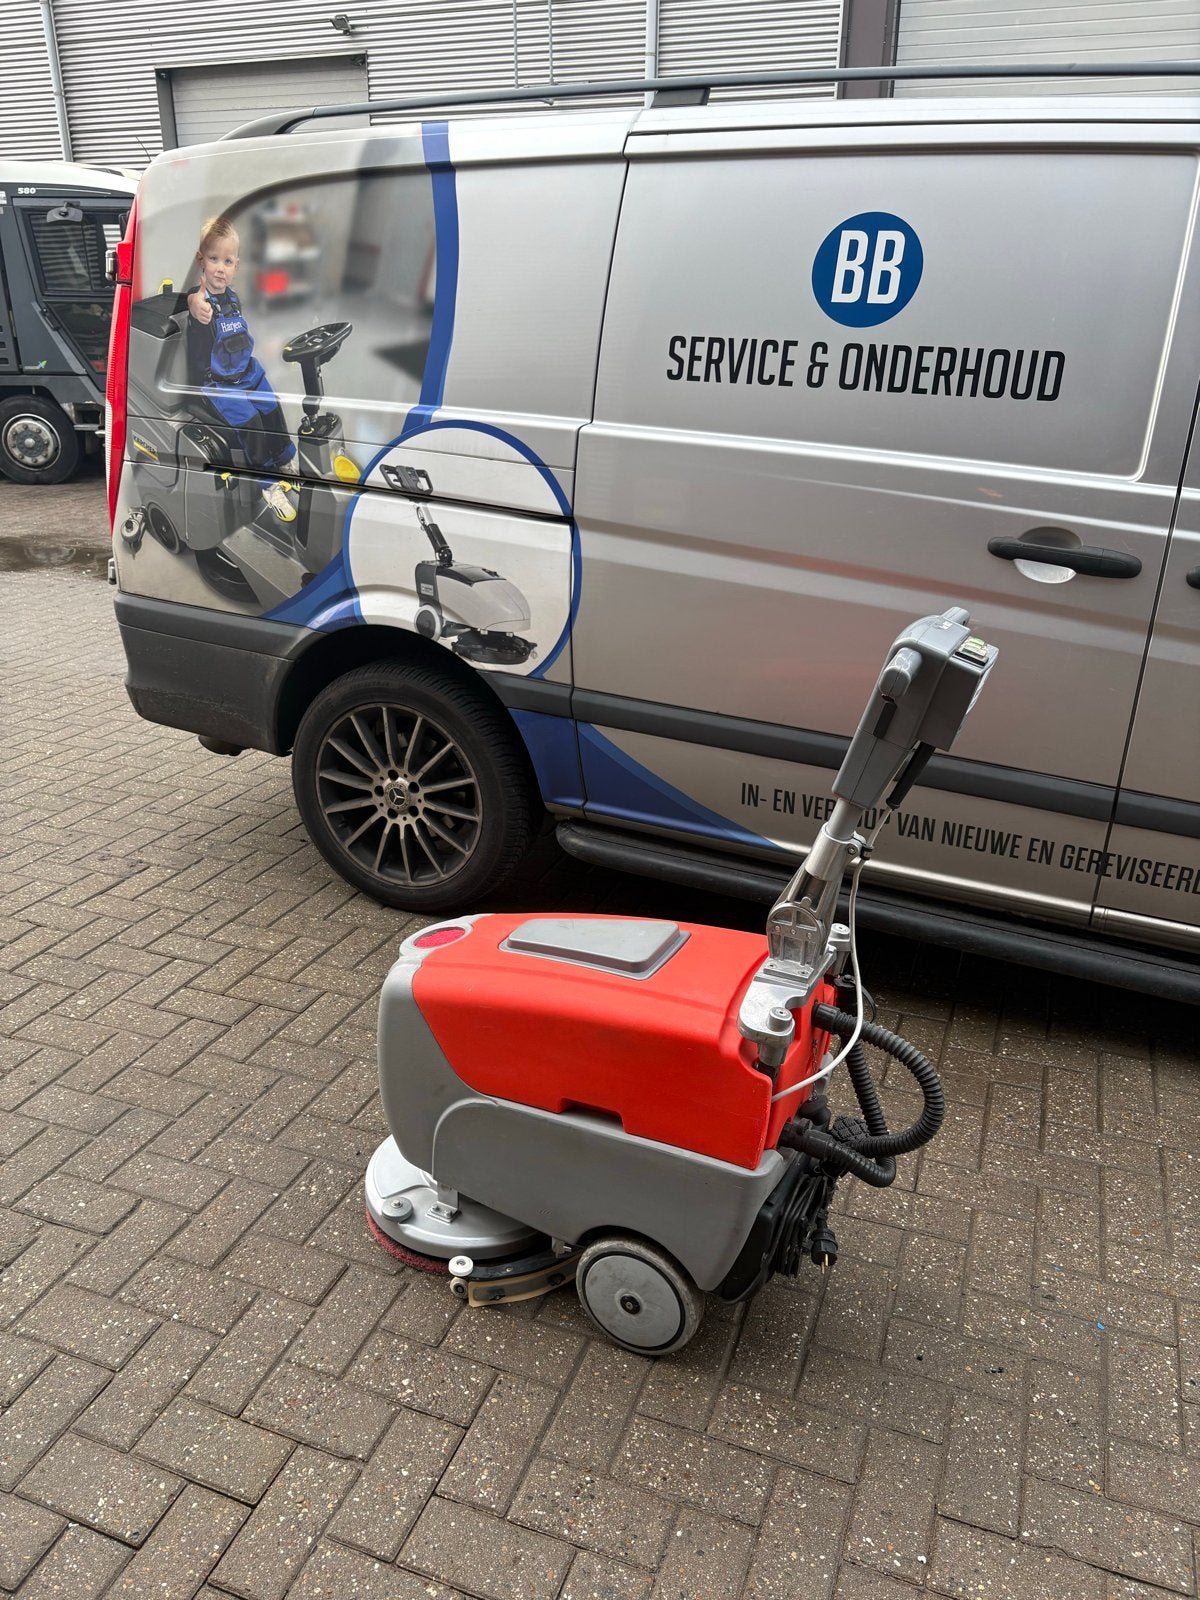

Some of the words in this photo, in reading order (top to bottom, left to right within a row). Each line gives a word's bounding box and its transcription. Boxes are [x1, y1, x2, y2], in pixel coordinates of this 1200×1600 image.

[17, 187, 37, 195] 580
[830, 230, 906, 304] BB
[220, 321, 243, 333] Harjen
[666, 335, 799, 387] SERVICE
[806, 341, 829, 389] &
[838, 342, 1066, 402] ONDERHOUD
[741, 782, 768, 808] IN-
[773, 789, 796, 815] EN
[897, 812, 936, 842] VAN
[941, 821, 1022, 859] NIEUWE
[1026, 837, 1055, 866] EN
